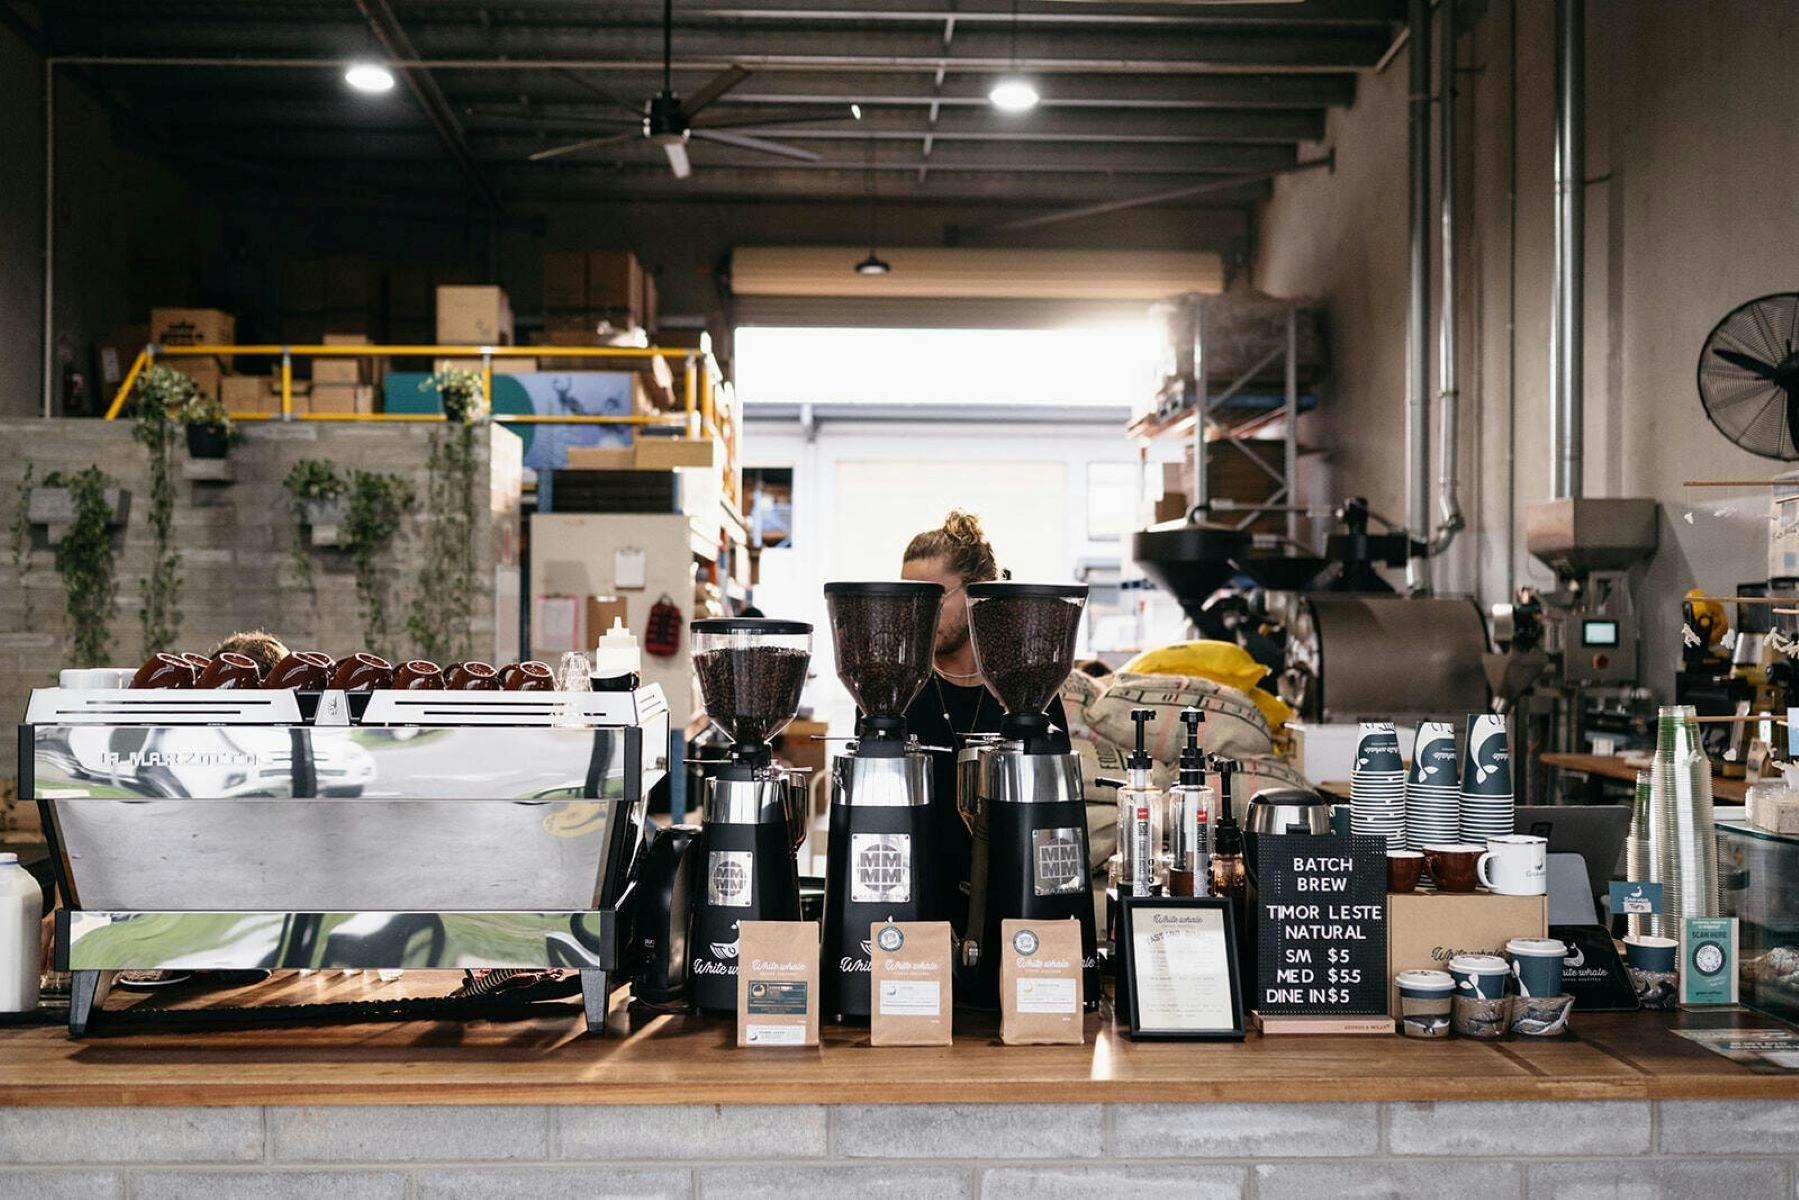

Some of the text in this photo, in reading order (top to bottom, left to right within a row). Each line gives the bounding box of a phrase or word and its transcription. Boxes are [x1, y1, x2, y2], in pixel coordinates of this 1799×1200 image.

[1293, 857, 1353, 872] BATCH
[1297, 877, 1347, 892] BREW
[1266, 905, 1383, 920] TIMOR LESTE
[1285, 925, 1367, 940] NATURAL
[1285, 947, 1350, 964] SM $5
[693, 958, 728, 974] White
[1277, 969, 1315, 984] MED
[1266, 986, 1350, 1004] DINE IN $5
